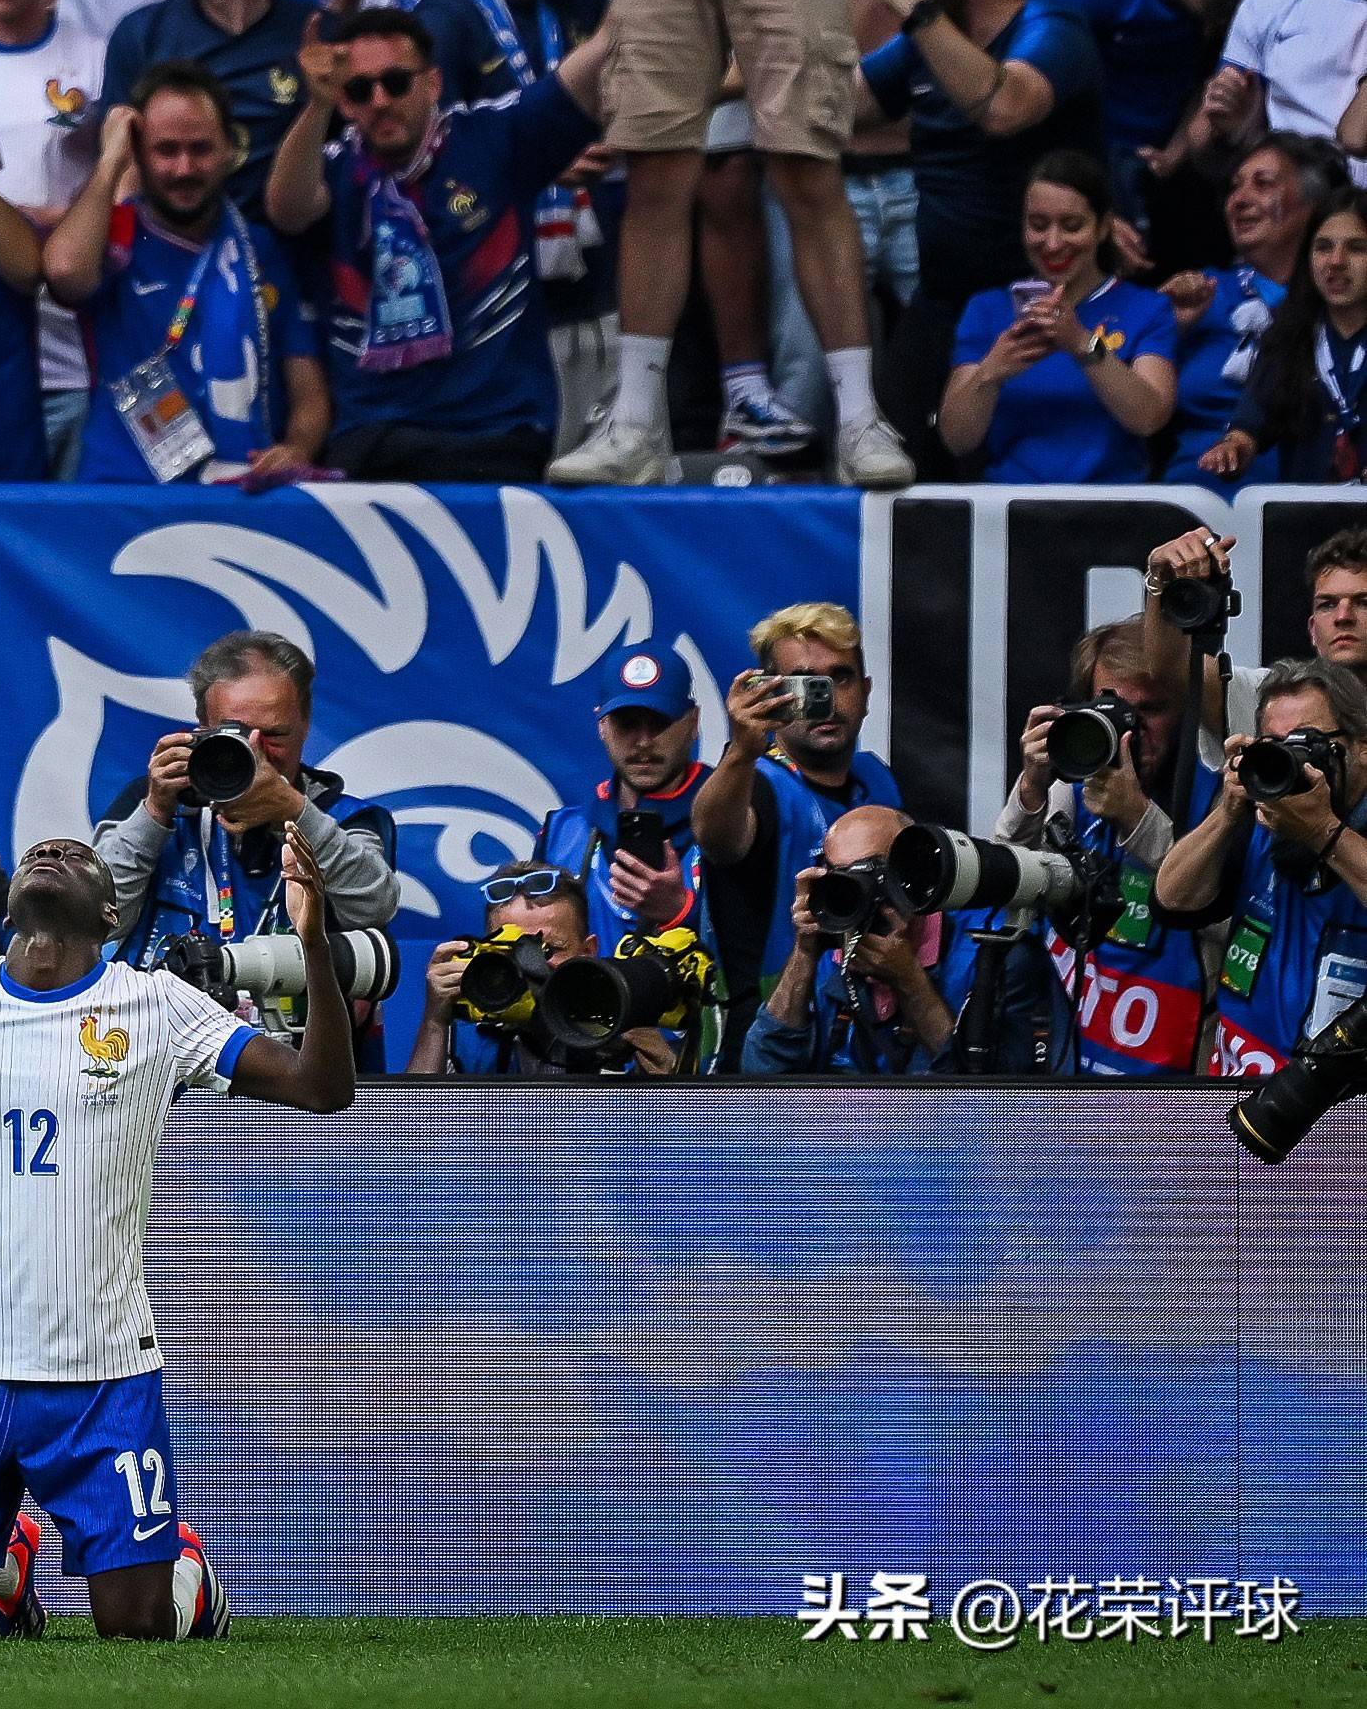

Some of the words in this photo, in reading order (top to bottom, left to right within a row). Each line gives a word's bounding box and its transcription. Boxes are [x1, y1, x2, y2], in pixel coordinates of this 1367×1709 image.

[1226, 943, 1260, 972] 078
[1078, 962, 1159, 1048] TO
[3, 1108, 60, 1176] 12
[114, 1448, 172, 1518] 12
